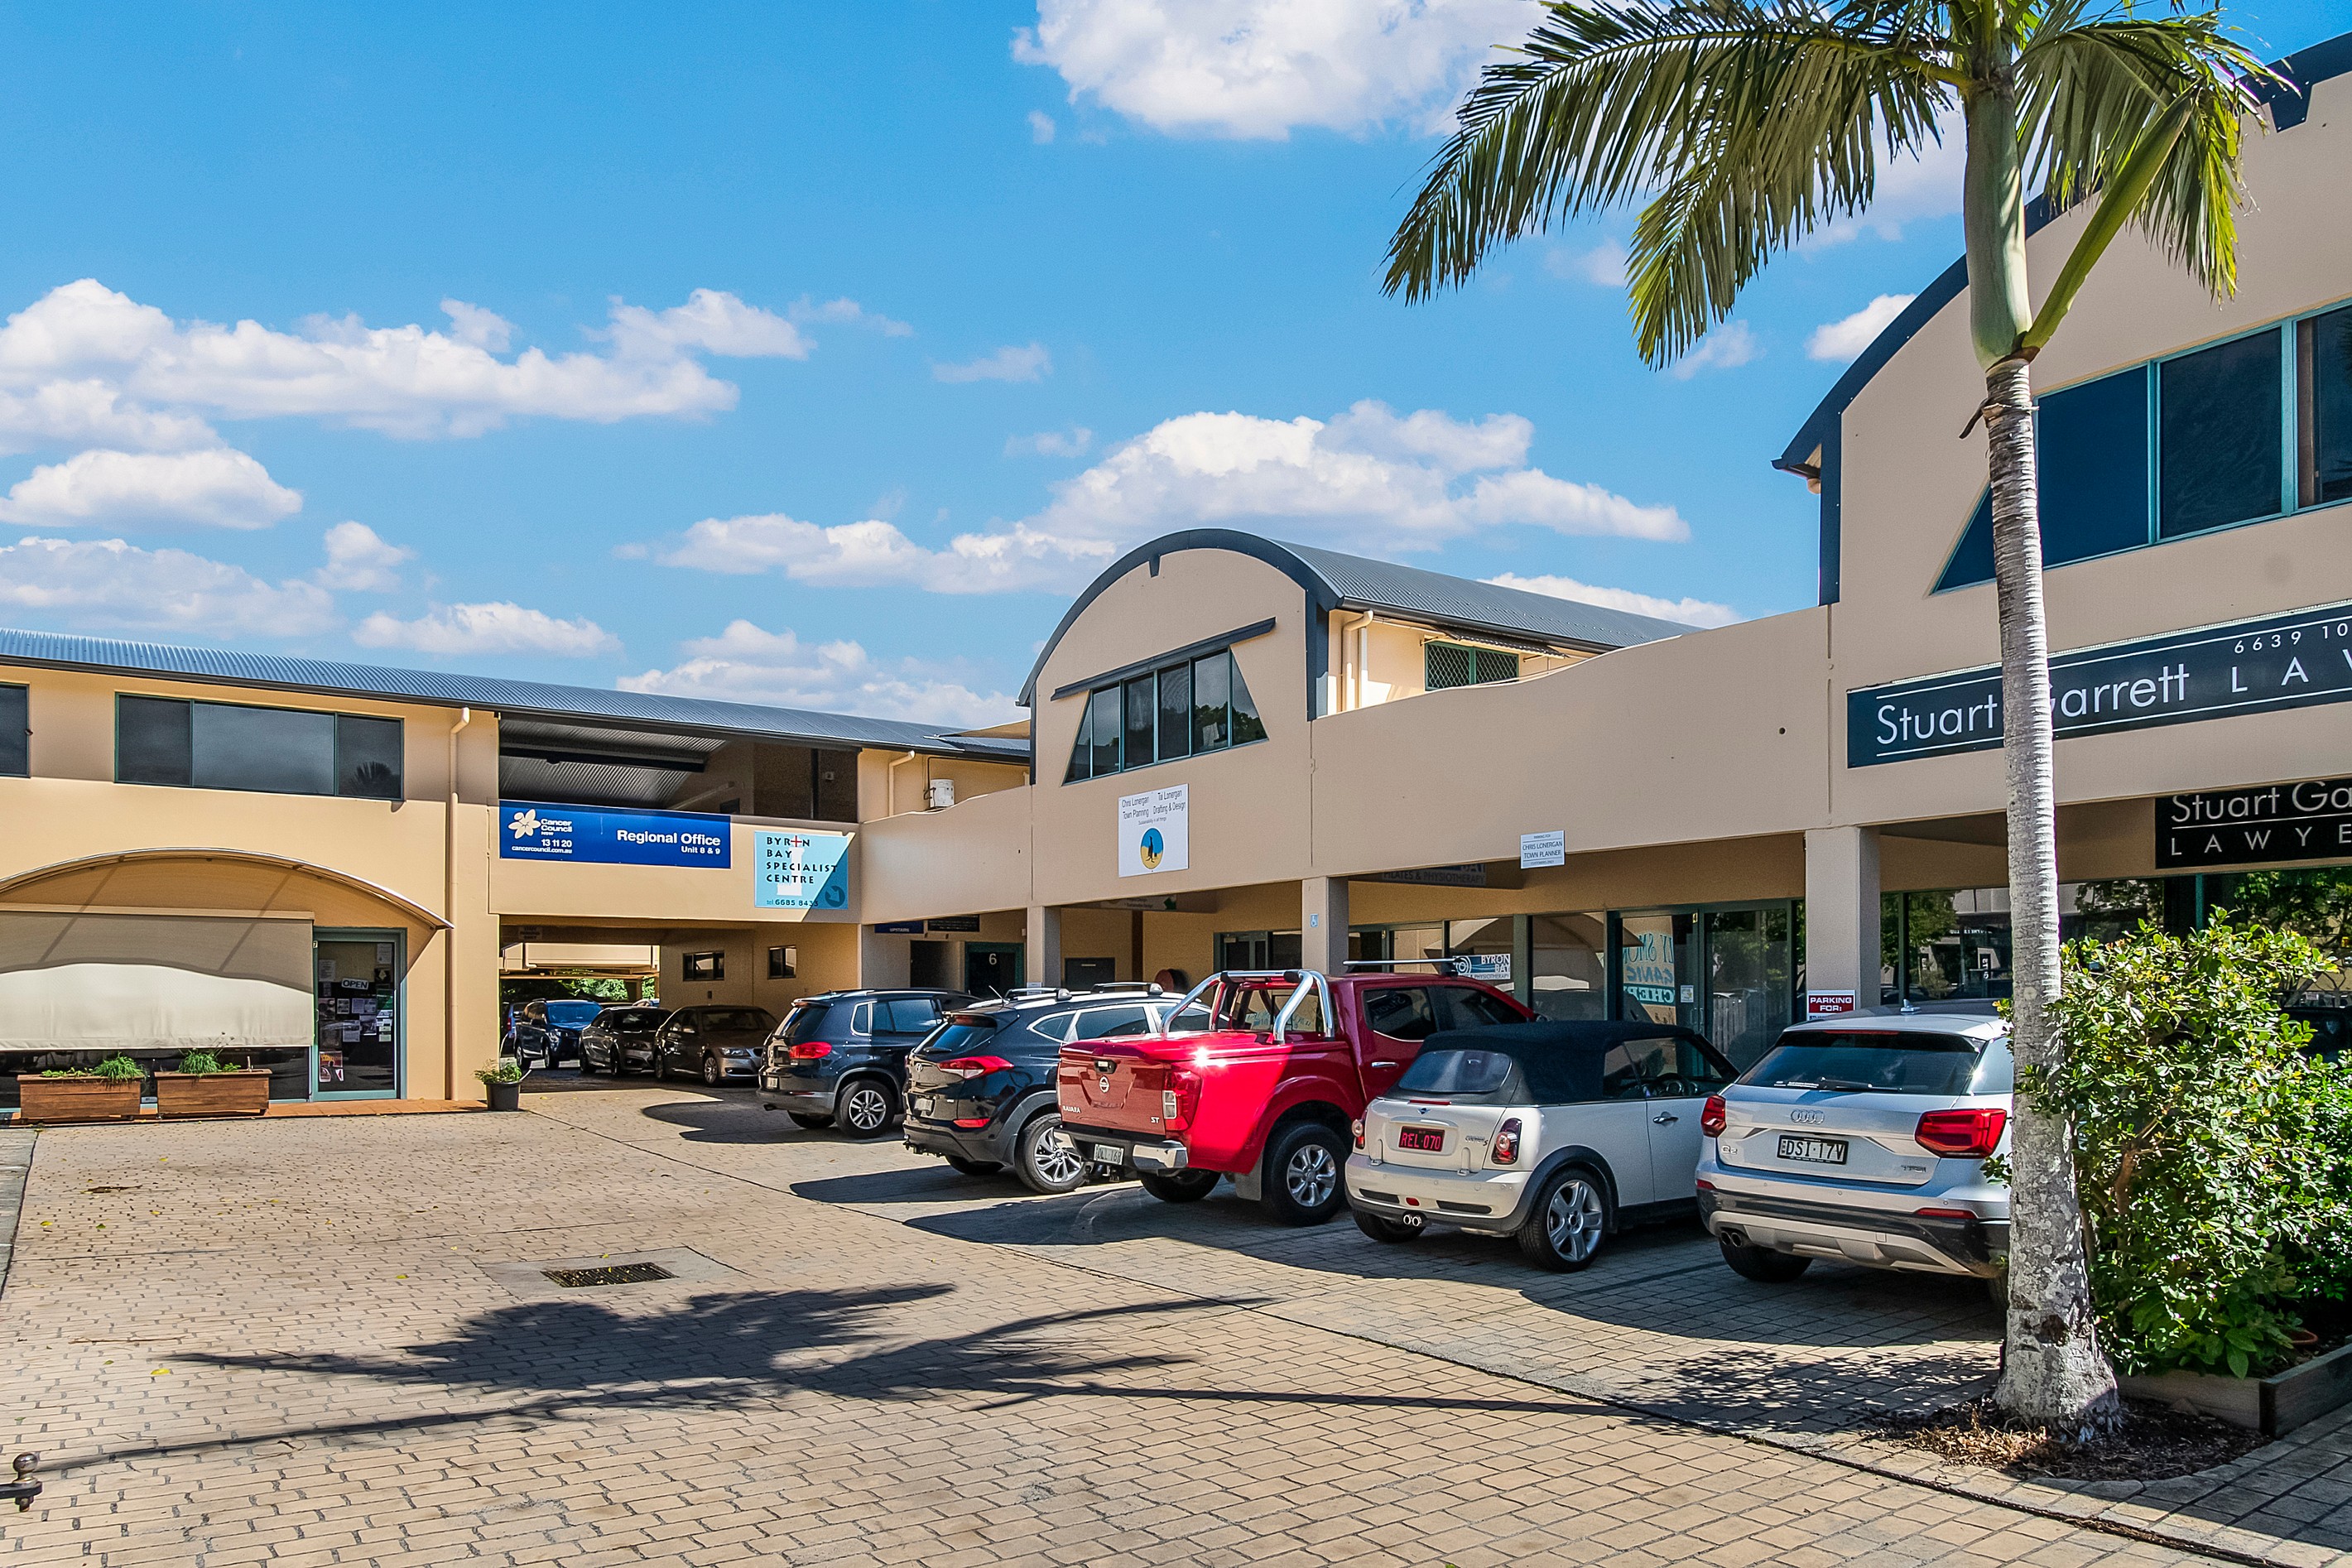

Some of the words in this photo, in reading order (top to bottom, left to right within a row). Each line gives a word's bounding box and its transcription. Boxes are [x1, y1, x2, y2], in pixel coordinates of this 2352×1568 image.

[2234, 631, 2301, 654] 6639
[2322, 623, 2349, 639] 10
[1876, 694, 1998, 745] Stuart
[2049, 662, 2191, 718] arrett
[1169, 802, 1172, 811] &
[2171, 786, 2281, 823] Stuart
[541, 818, 572, 826] Cancer
[617, 830, 677, 844] Regional
[681, 833, 721, 846] Office
[2171, 823, 2352, 856] LAWYE
[541, 839, 551, 847] 13
[552, 839, 560, 847] 11
[561, 839, 573, 848] 20
[1522, 843, 1536, 851] CHRIS
[512, 845, 573, 854] cancercouncil.com.au
[681, 845, 698, 854] Unit
[767, 849, 792, 859] BAY
[1524, 851, 1538, 859] TOWN
[1540, 849, 1561, 858] PLANNER
[766, 861, 838, 873] SPECIALIST
[766, 873, 815, 884] CENTRE
[1423, 872, 1485, 883] PHYSIOTHERAPY
[988, 953, 997, 965] 6
[1481, 955, 1509, 964] BYRON
[1494, 963, 1510, 973] BAY
[343, 979, 368, 989] OPEN
